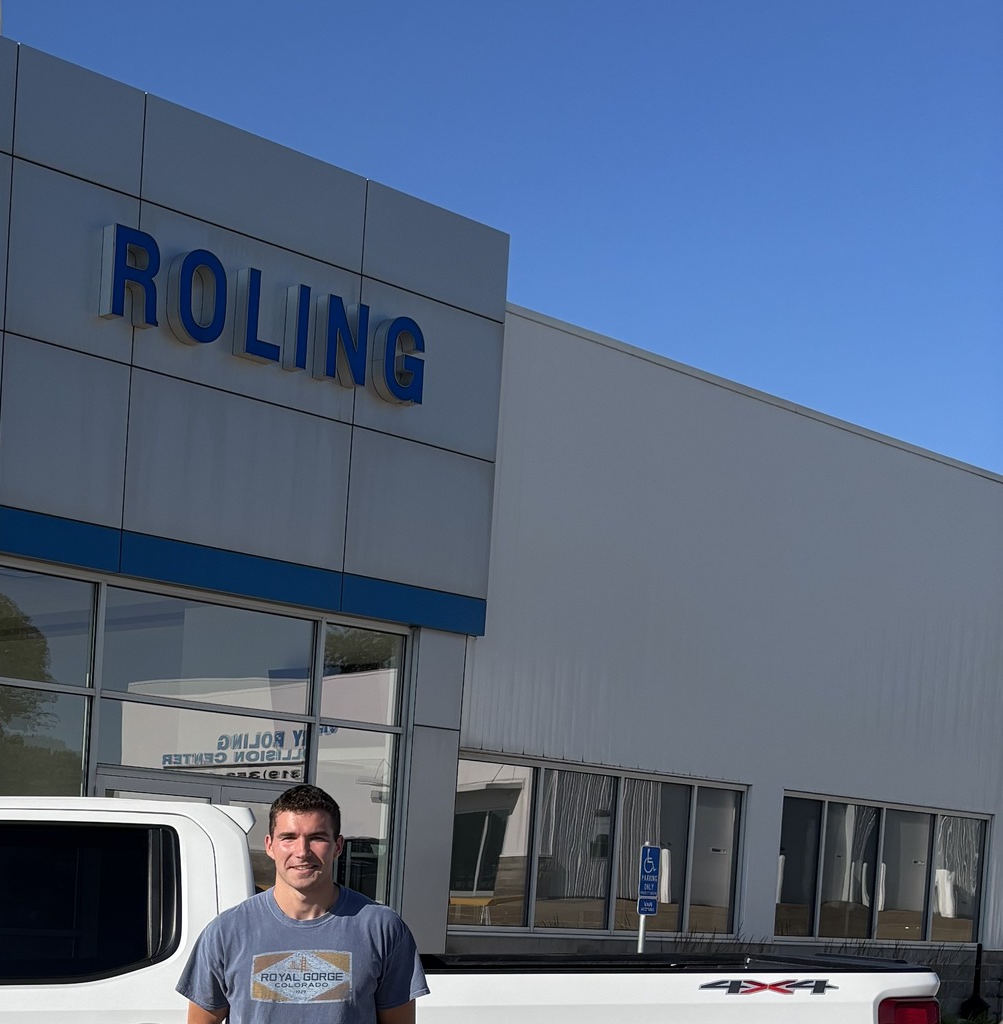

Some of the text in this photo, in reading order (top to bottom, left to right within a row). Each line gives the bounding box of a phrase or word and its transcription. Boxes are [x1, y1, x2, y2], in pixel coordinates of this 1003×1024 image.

[102, 223, 425, 406] ROLING
[641, 874, 657, 882] PARKING
[260, 972, 343, 982] ROYAL GORGE
[698, 979, 839, 995] 4X4
